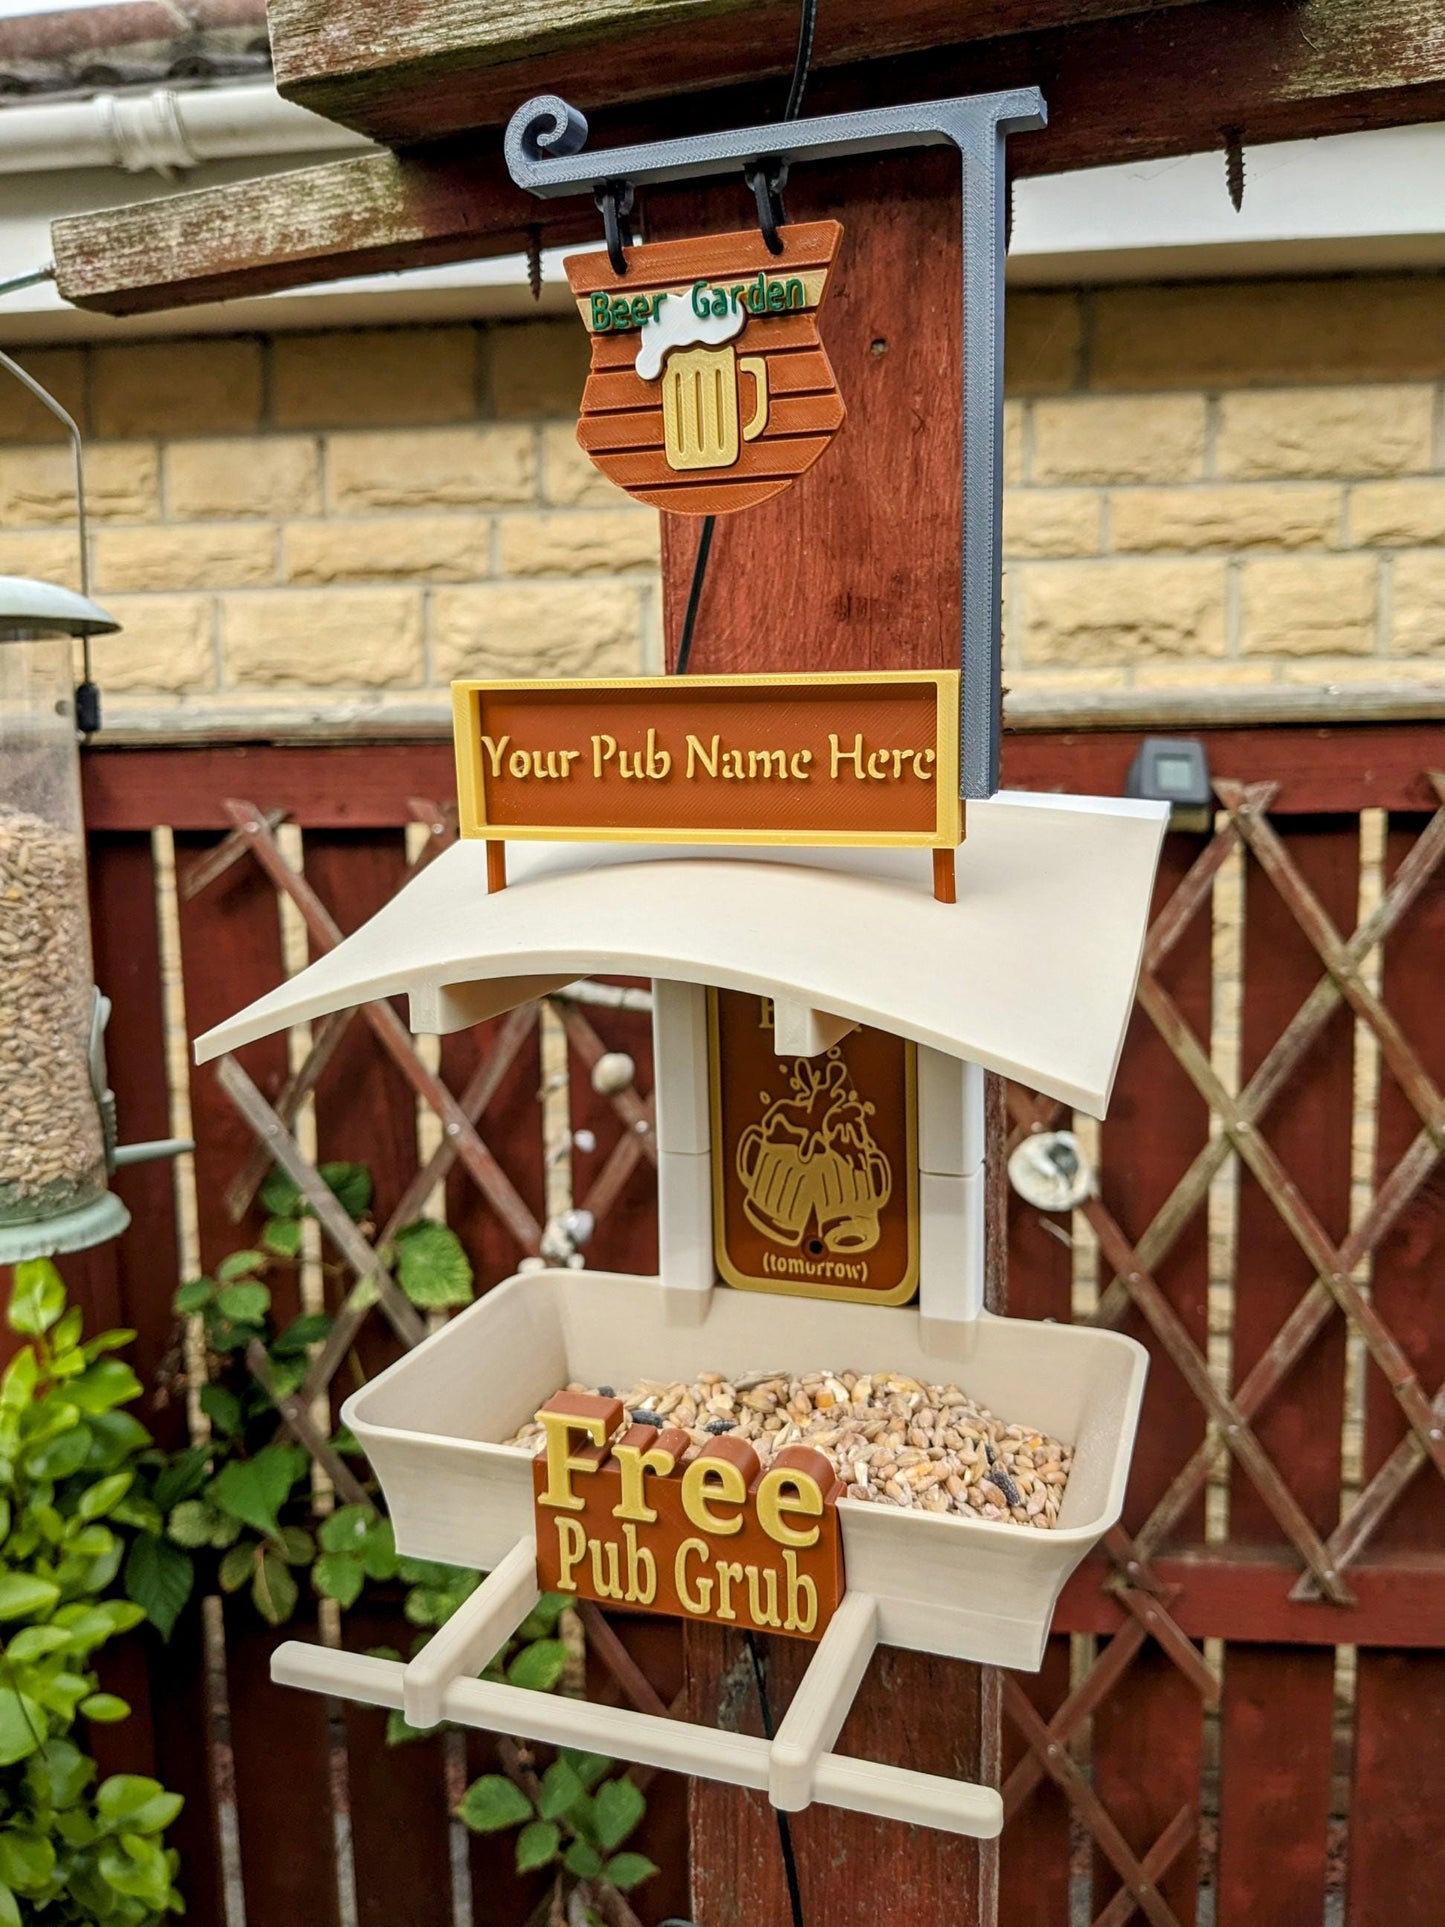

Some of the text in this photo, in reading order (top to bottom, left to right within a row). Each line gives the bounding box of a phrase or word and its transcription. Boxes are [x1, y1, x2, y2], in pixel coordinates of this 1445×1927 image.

[590, 272, 805, 330] Beer Garden
[481, 728, 937, 781] Your Pub Name Here
[762, 1251, 868, 1282] (tomorrow)
[534, 1409, 824, 1547] Free
[554, 1515, 818, 1634] Pub Grub
